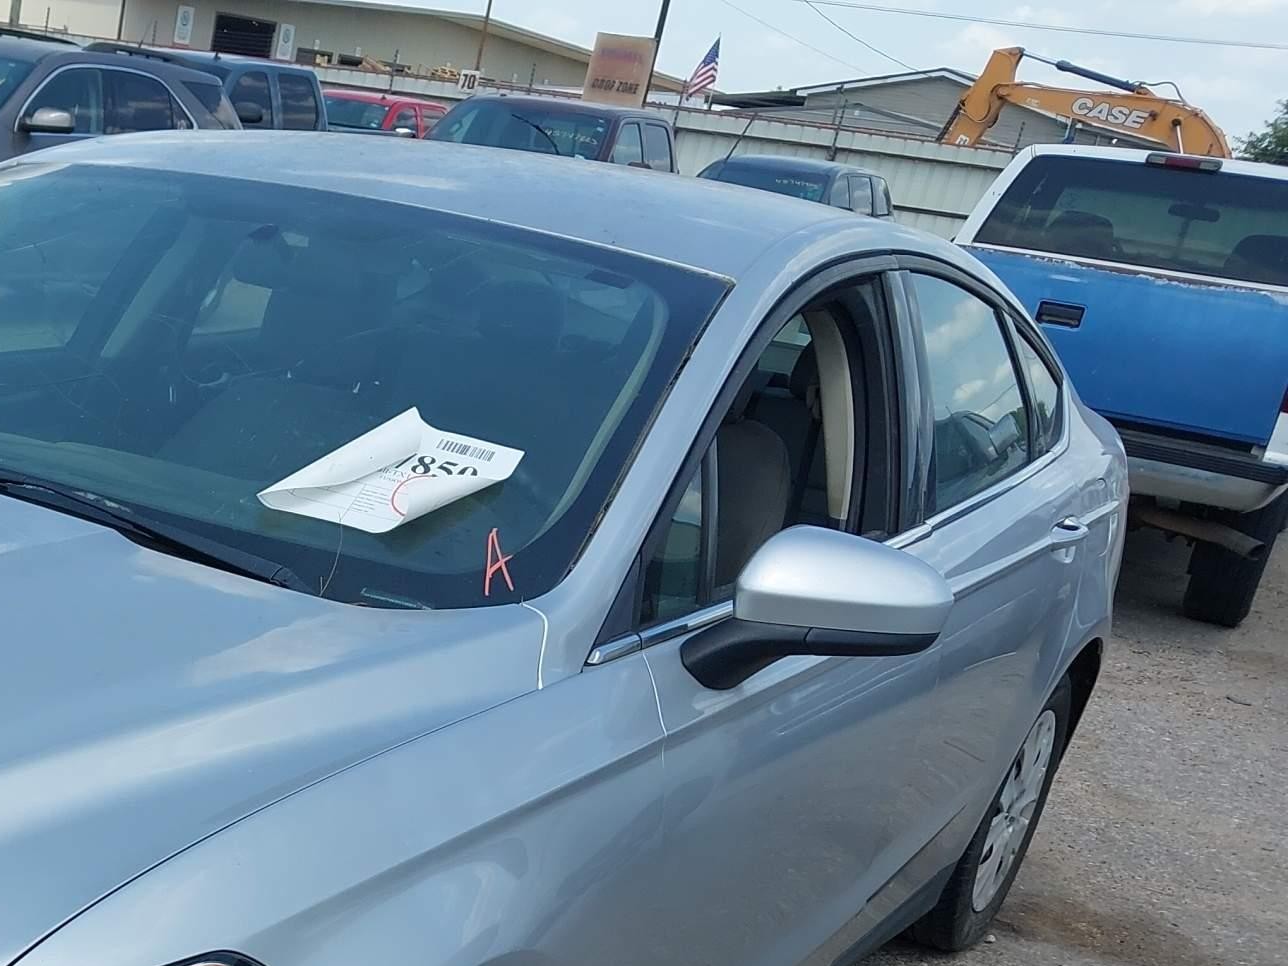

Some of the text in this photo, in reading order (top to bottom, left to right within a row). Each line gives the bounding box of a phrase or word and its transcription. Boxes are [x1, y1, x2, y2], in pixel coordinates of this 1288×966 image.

[462, 72, 477, 90] 70
[1071, 97, 1149, 128] CASE
[484, 528, 514, 596] A
